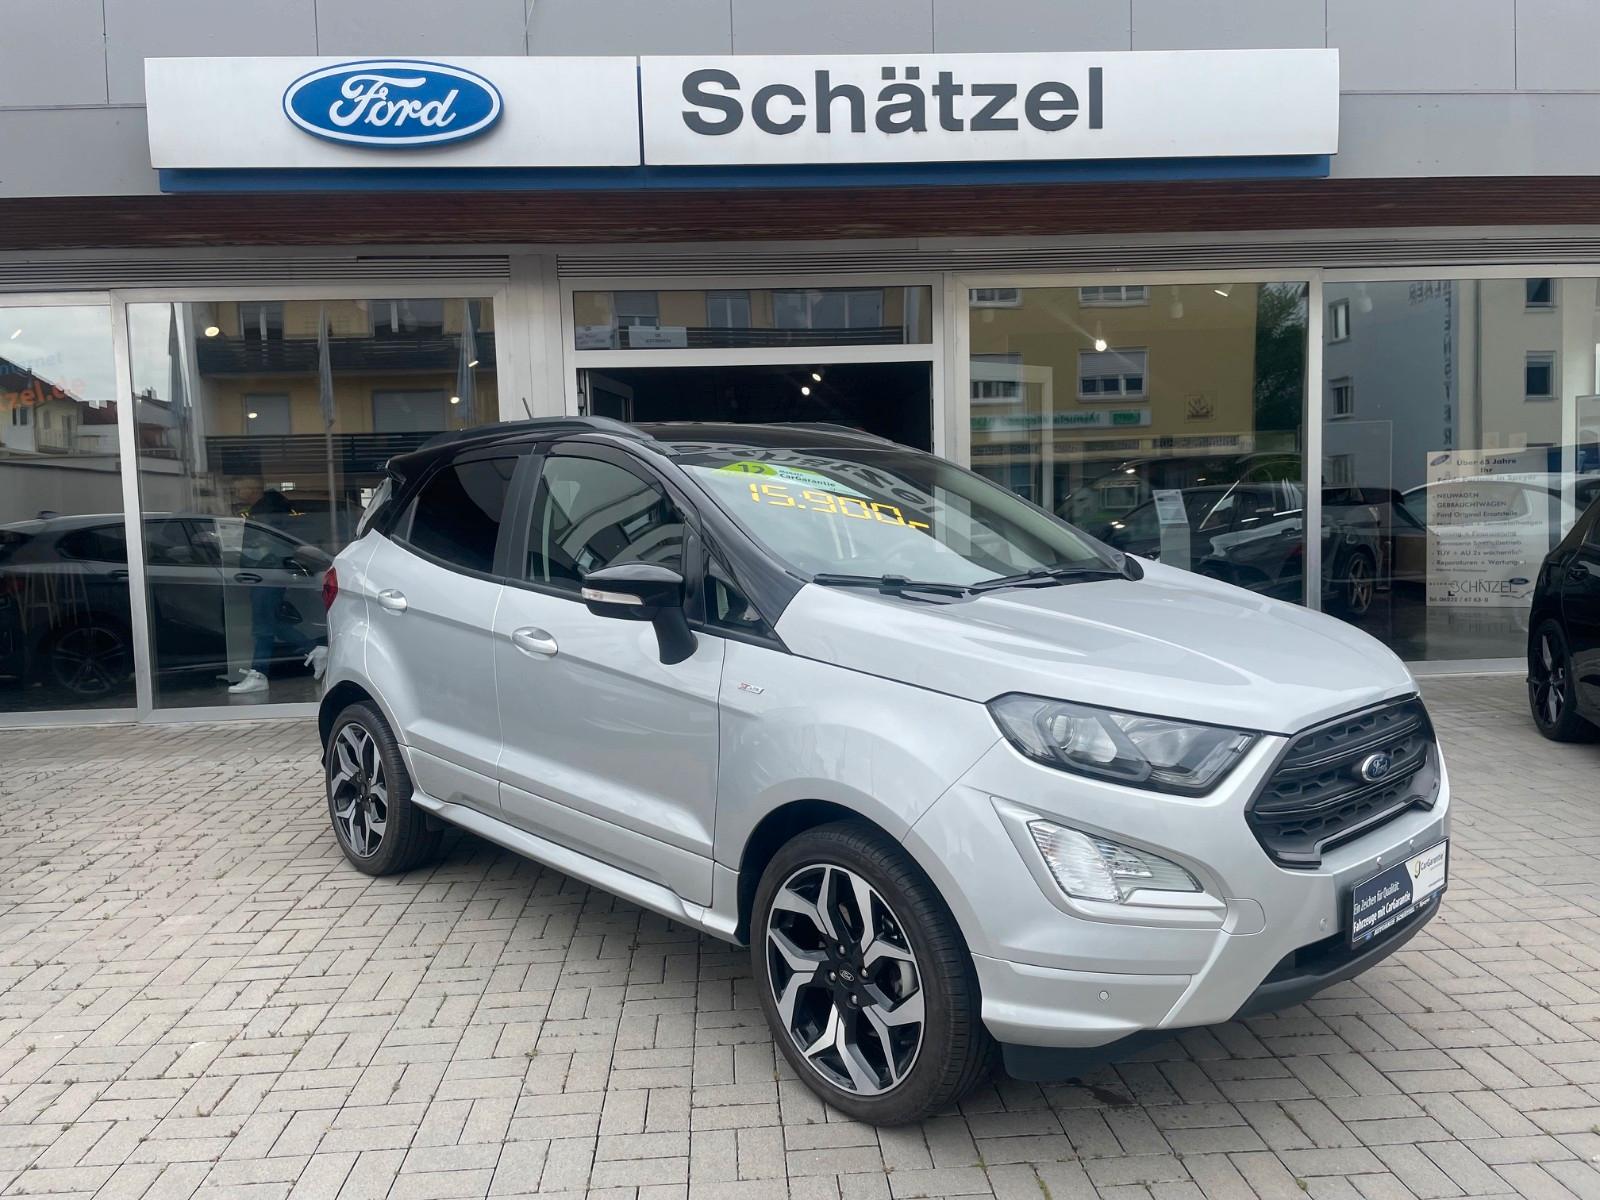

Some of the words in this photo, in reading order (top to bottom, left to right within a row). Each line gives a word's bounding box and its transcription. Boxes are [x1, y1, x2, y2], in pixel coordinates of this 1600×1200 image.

[329, 74, 460, 128] Ford
[682, 66, 1104, 136] Schätzel
[779, 473, 836, 488] CarGarantie
[1437, 501, 1506, 509] GEBRAUCHTWAGEN
[1353, 903, 1361, 915] Ein
[1360, 894, 1377, 911] Zeichen
[1353, 912, 1377, 933] Fahrzeuge
[1377, 906, 1386, 919] mit
